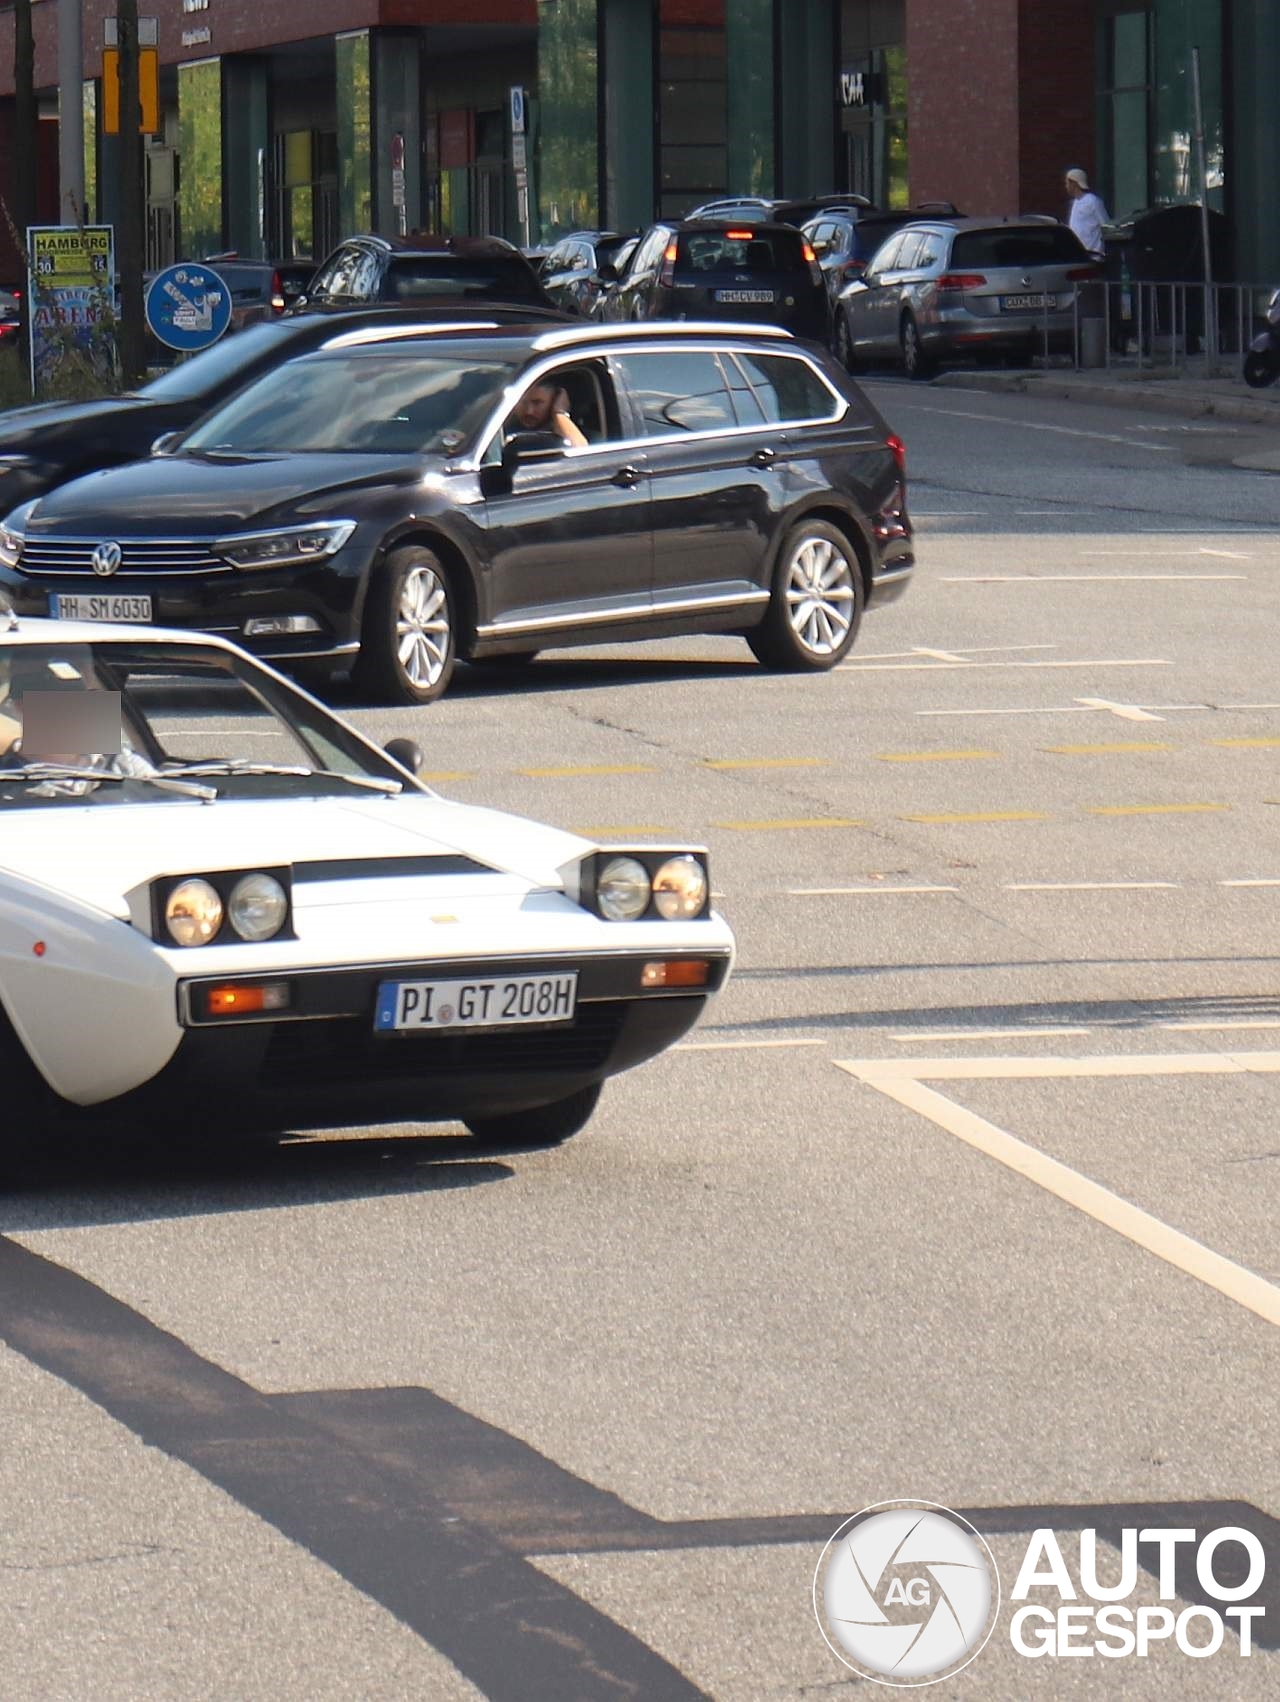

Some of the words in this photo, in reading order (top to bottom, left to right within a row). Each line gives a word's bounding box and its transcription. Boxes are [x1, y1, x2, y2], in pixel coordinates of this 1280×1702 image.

[61, 598, 78, 618] HH
[90, 598, 108, 618] SM
[113, 598, 150, 618] 6030
[402, 987, 435, 1023] PI
[459, 985, 495, 1021] GT
[502, 979, 572, 1018] 208H
